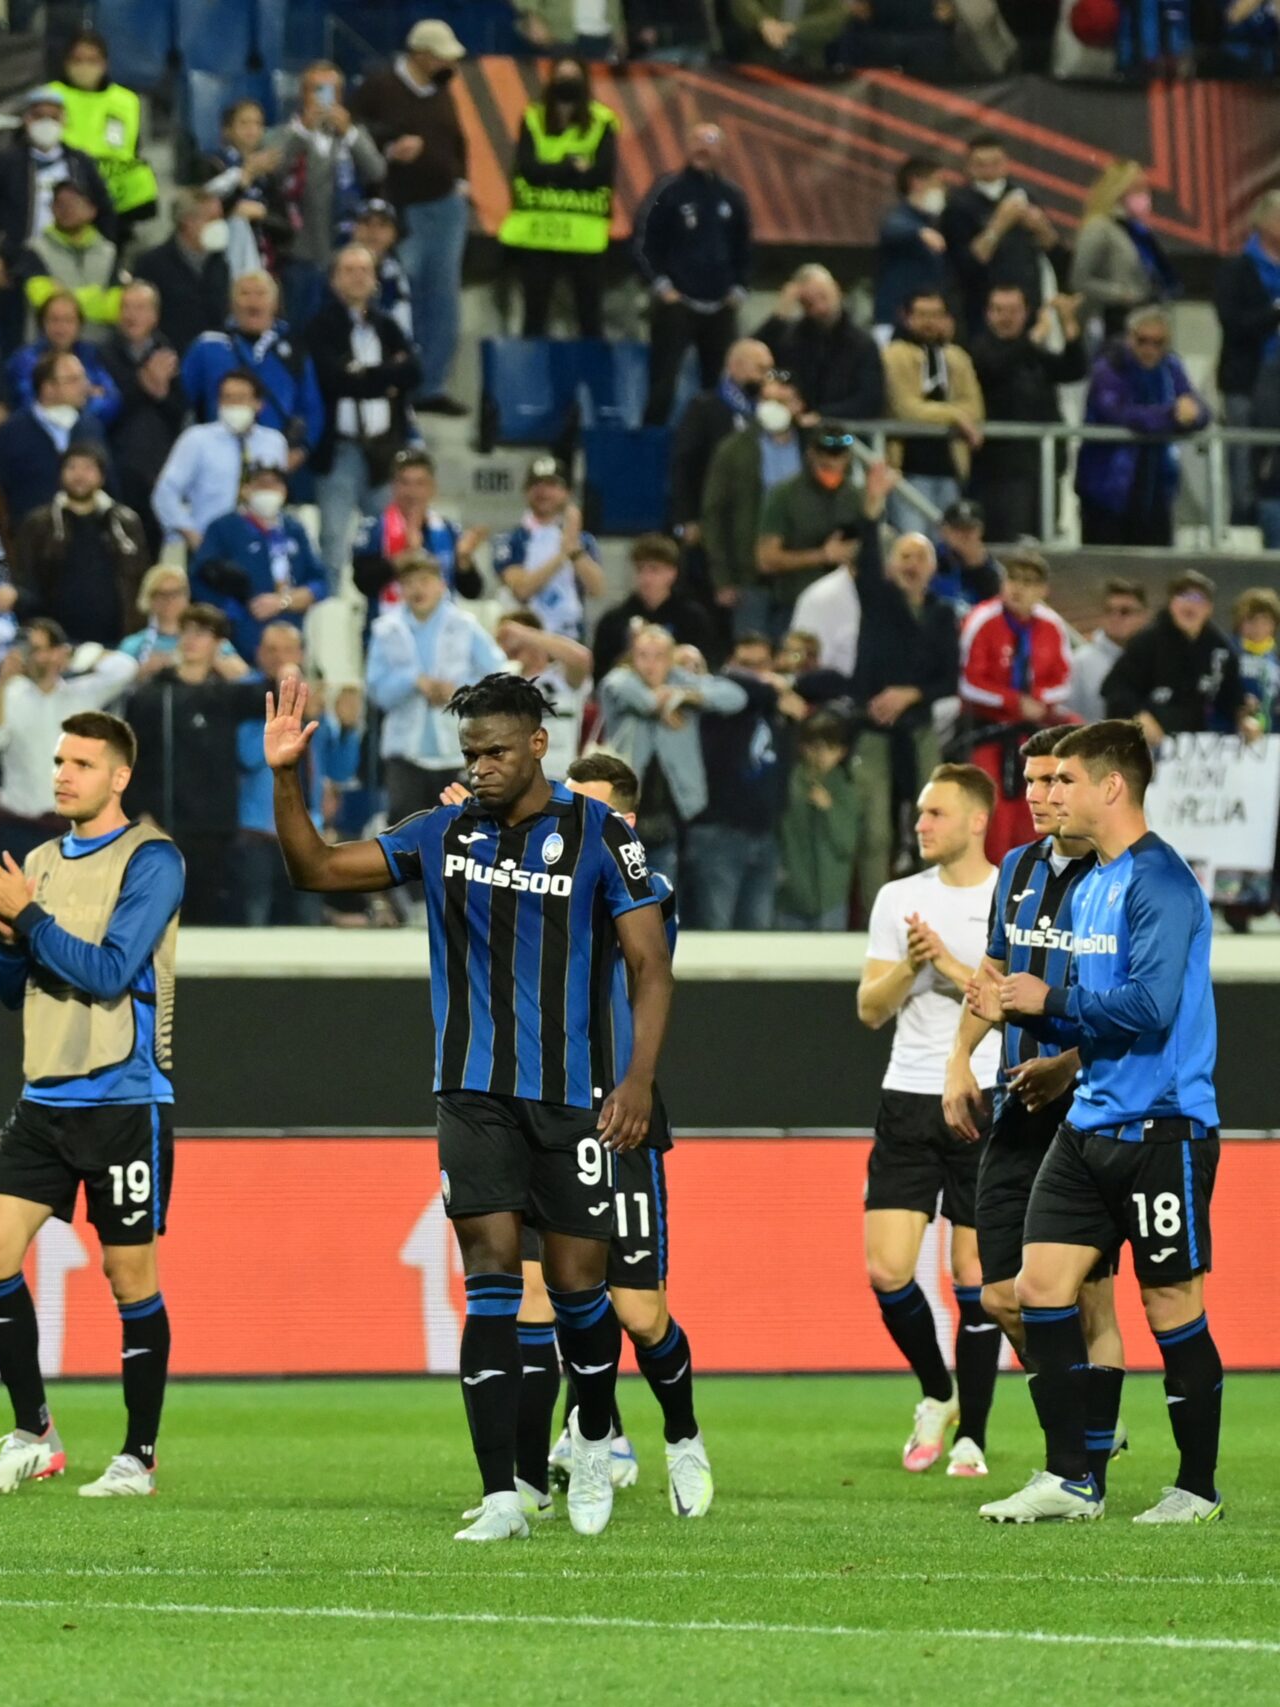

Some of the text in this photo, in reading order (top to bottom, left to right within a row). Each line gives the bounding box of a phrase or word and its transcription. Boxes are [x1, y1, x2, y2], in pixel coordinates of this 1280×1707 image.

[444, 854, 572, 897] Plus500
[108, 1160, 150, 1205] 19
[615, 1192, 650, 1237] 11
[1132, 1192, 1181, 1238] 18
